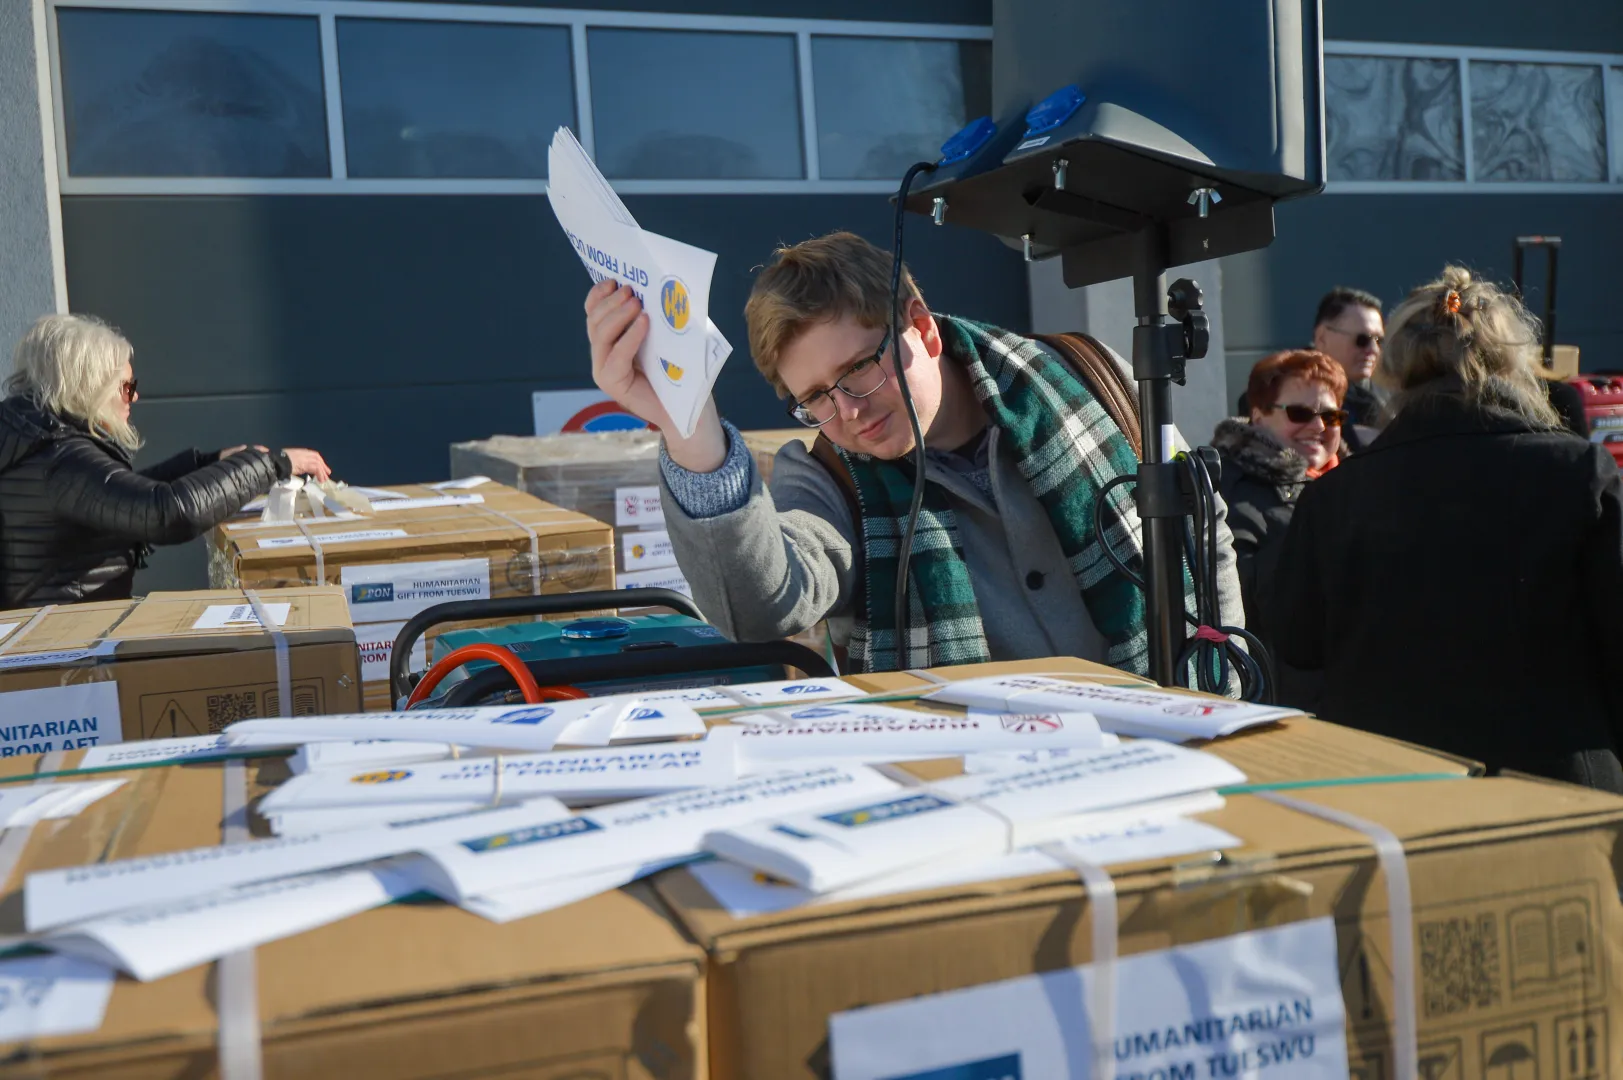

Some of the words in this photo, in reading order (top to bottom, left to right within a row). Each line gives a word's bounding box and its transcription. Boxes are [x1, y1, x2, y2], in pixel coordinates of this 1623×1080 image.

[586, 244, 620, 274] FROM
[622, 262, 649, 287] GIFT
[413, 578, 481, 589] HUMANITARIAN
[397, 592, 416, 600] GIFT
[419, 589, 446, 599] FROM
[447, 587, 481, 598] TUESWU
[0, 741, 52, 758] ROM
[440, 771, 484, 782] GIF
[1114, 997, 1313, 1062] UMANITARIAN
